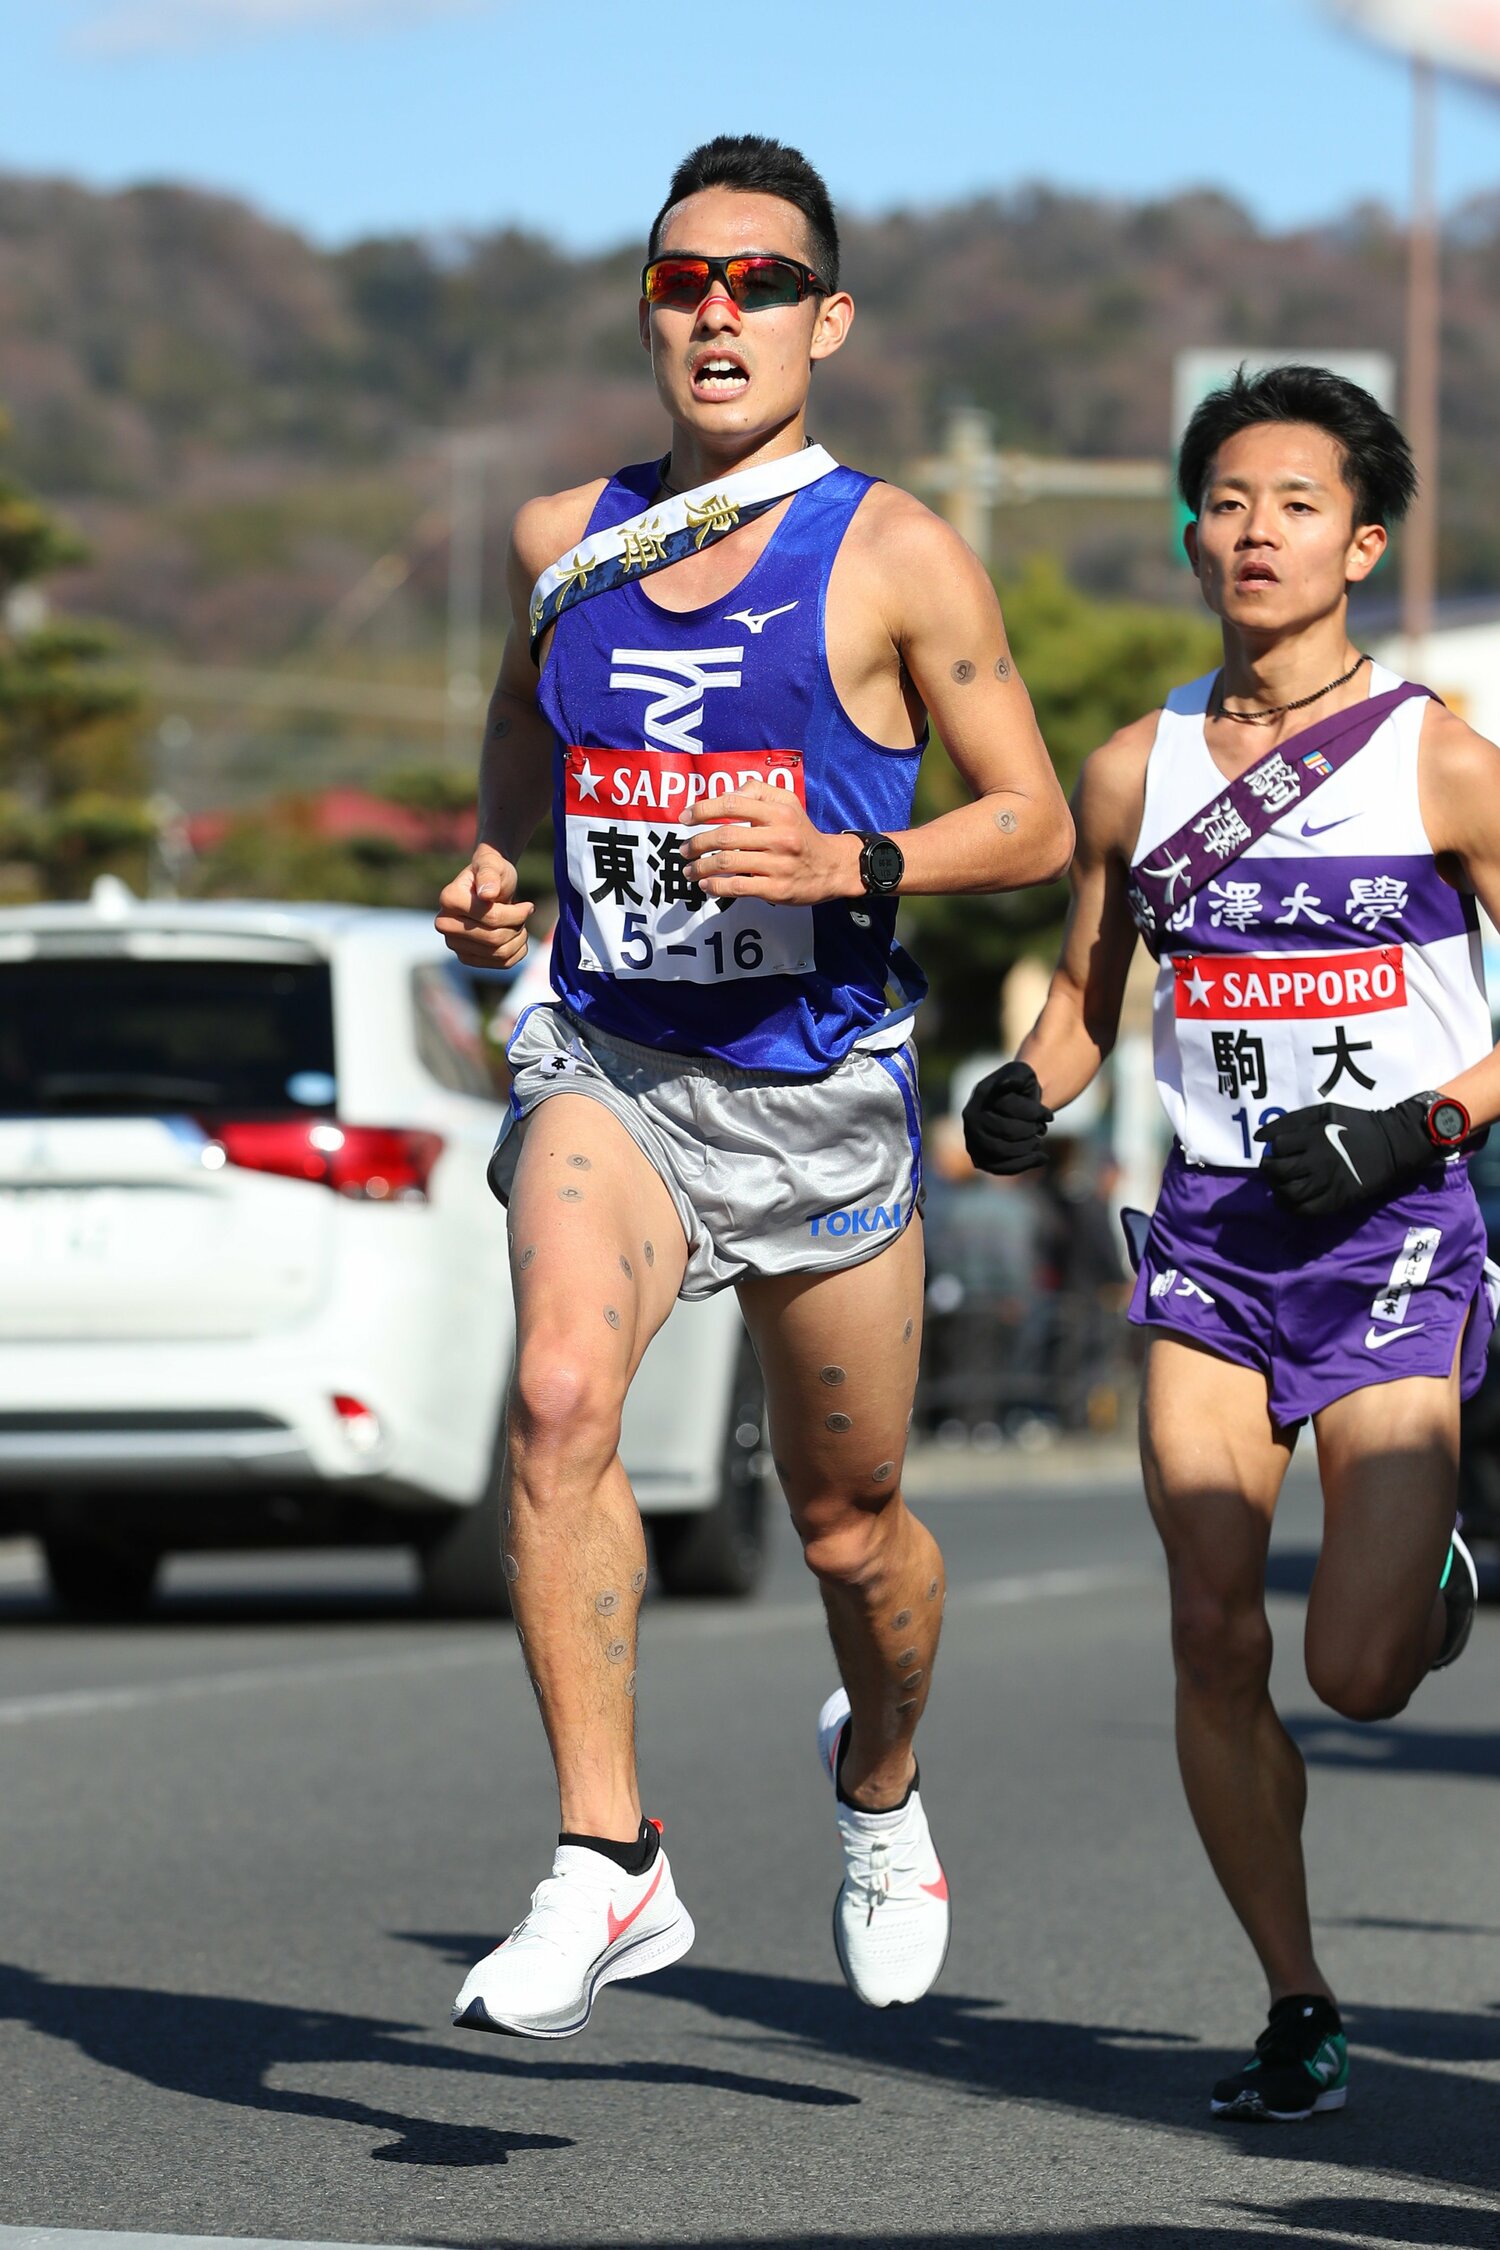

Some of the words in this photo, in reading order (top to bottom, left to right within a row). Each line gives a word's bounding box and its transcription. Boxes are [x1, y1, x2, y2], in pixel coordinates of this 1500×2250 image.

[587, 826, 776, 912] 東海
[1223, 964, 1396, 1008] SAPPORO
[806, 1203, 901, 1237] TOKAI
